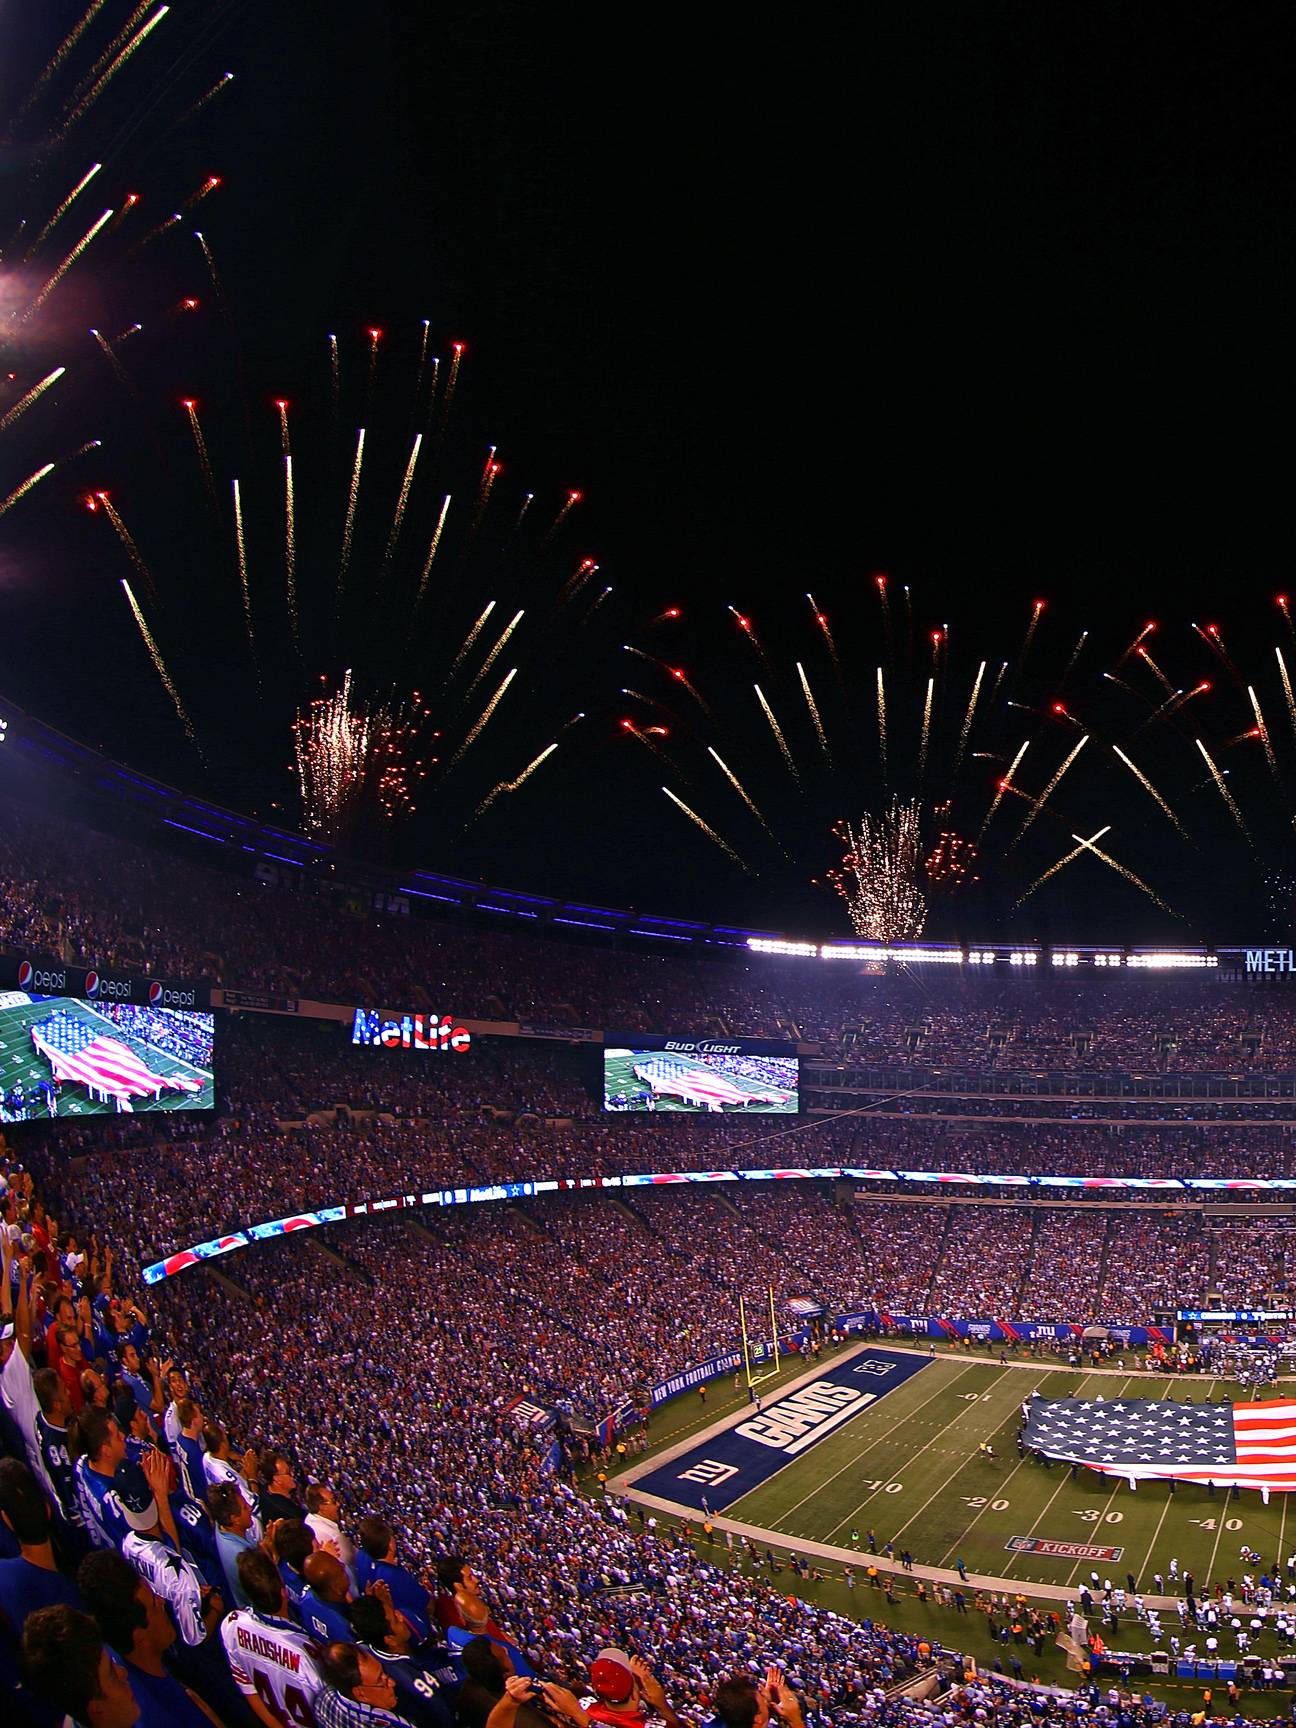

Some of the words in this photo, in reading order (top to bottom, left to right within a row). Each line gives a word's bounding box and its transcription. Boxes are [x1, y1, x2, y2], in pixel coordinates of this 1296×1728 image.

[33, 970, 67, 990] pepsi
[99, 980, 132, 1000] pepsi
[163, 989, 196, 1007] pepsi
[351, 1008, 472, 1052] MetLife
[664, 1041, 695, 1051] BUD
[703, 1043, 742, 1053] LIGHT
[653, 1386, 668, 1402] NEW
[667, 1376, 685, 1394] YORK
[685, 1364, 715, 1388] FOOTBALL
[734, 1380, 864, 1449] GIANTS
[866, 1479, 904, 1494] 10
[966, 1496, 1010, 1511] 20
[1080, 1509, 1124, 1524] 30
[1200, 1518, 1244, 1531] 40
[1040, 1543, 1109, 1558] KICKOFF
[236, 1625, 301, 1674] BRADSHAW
[413, 1669, 442, 1699] 94
